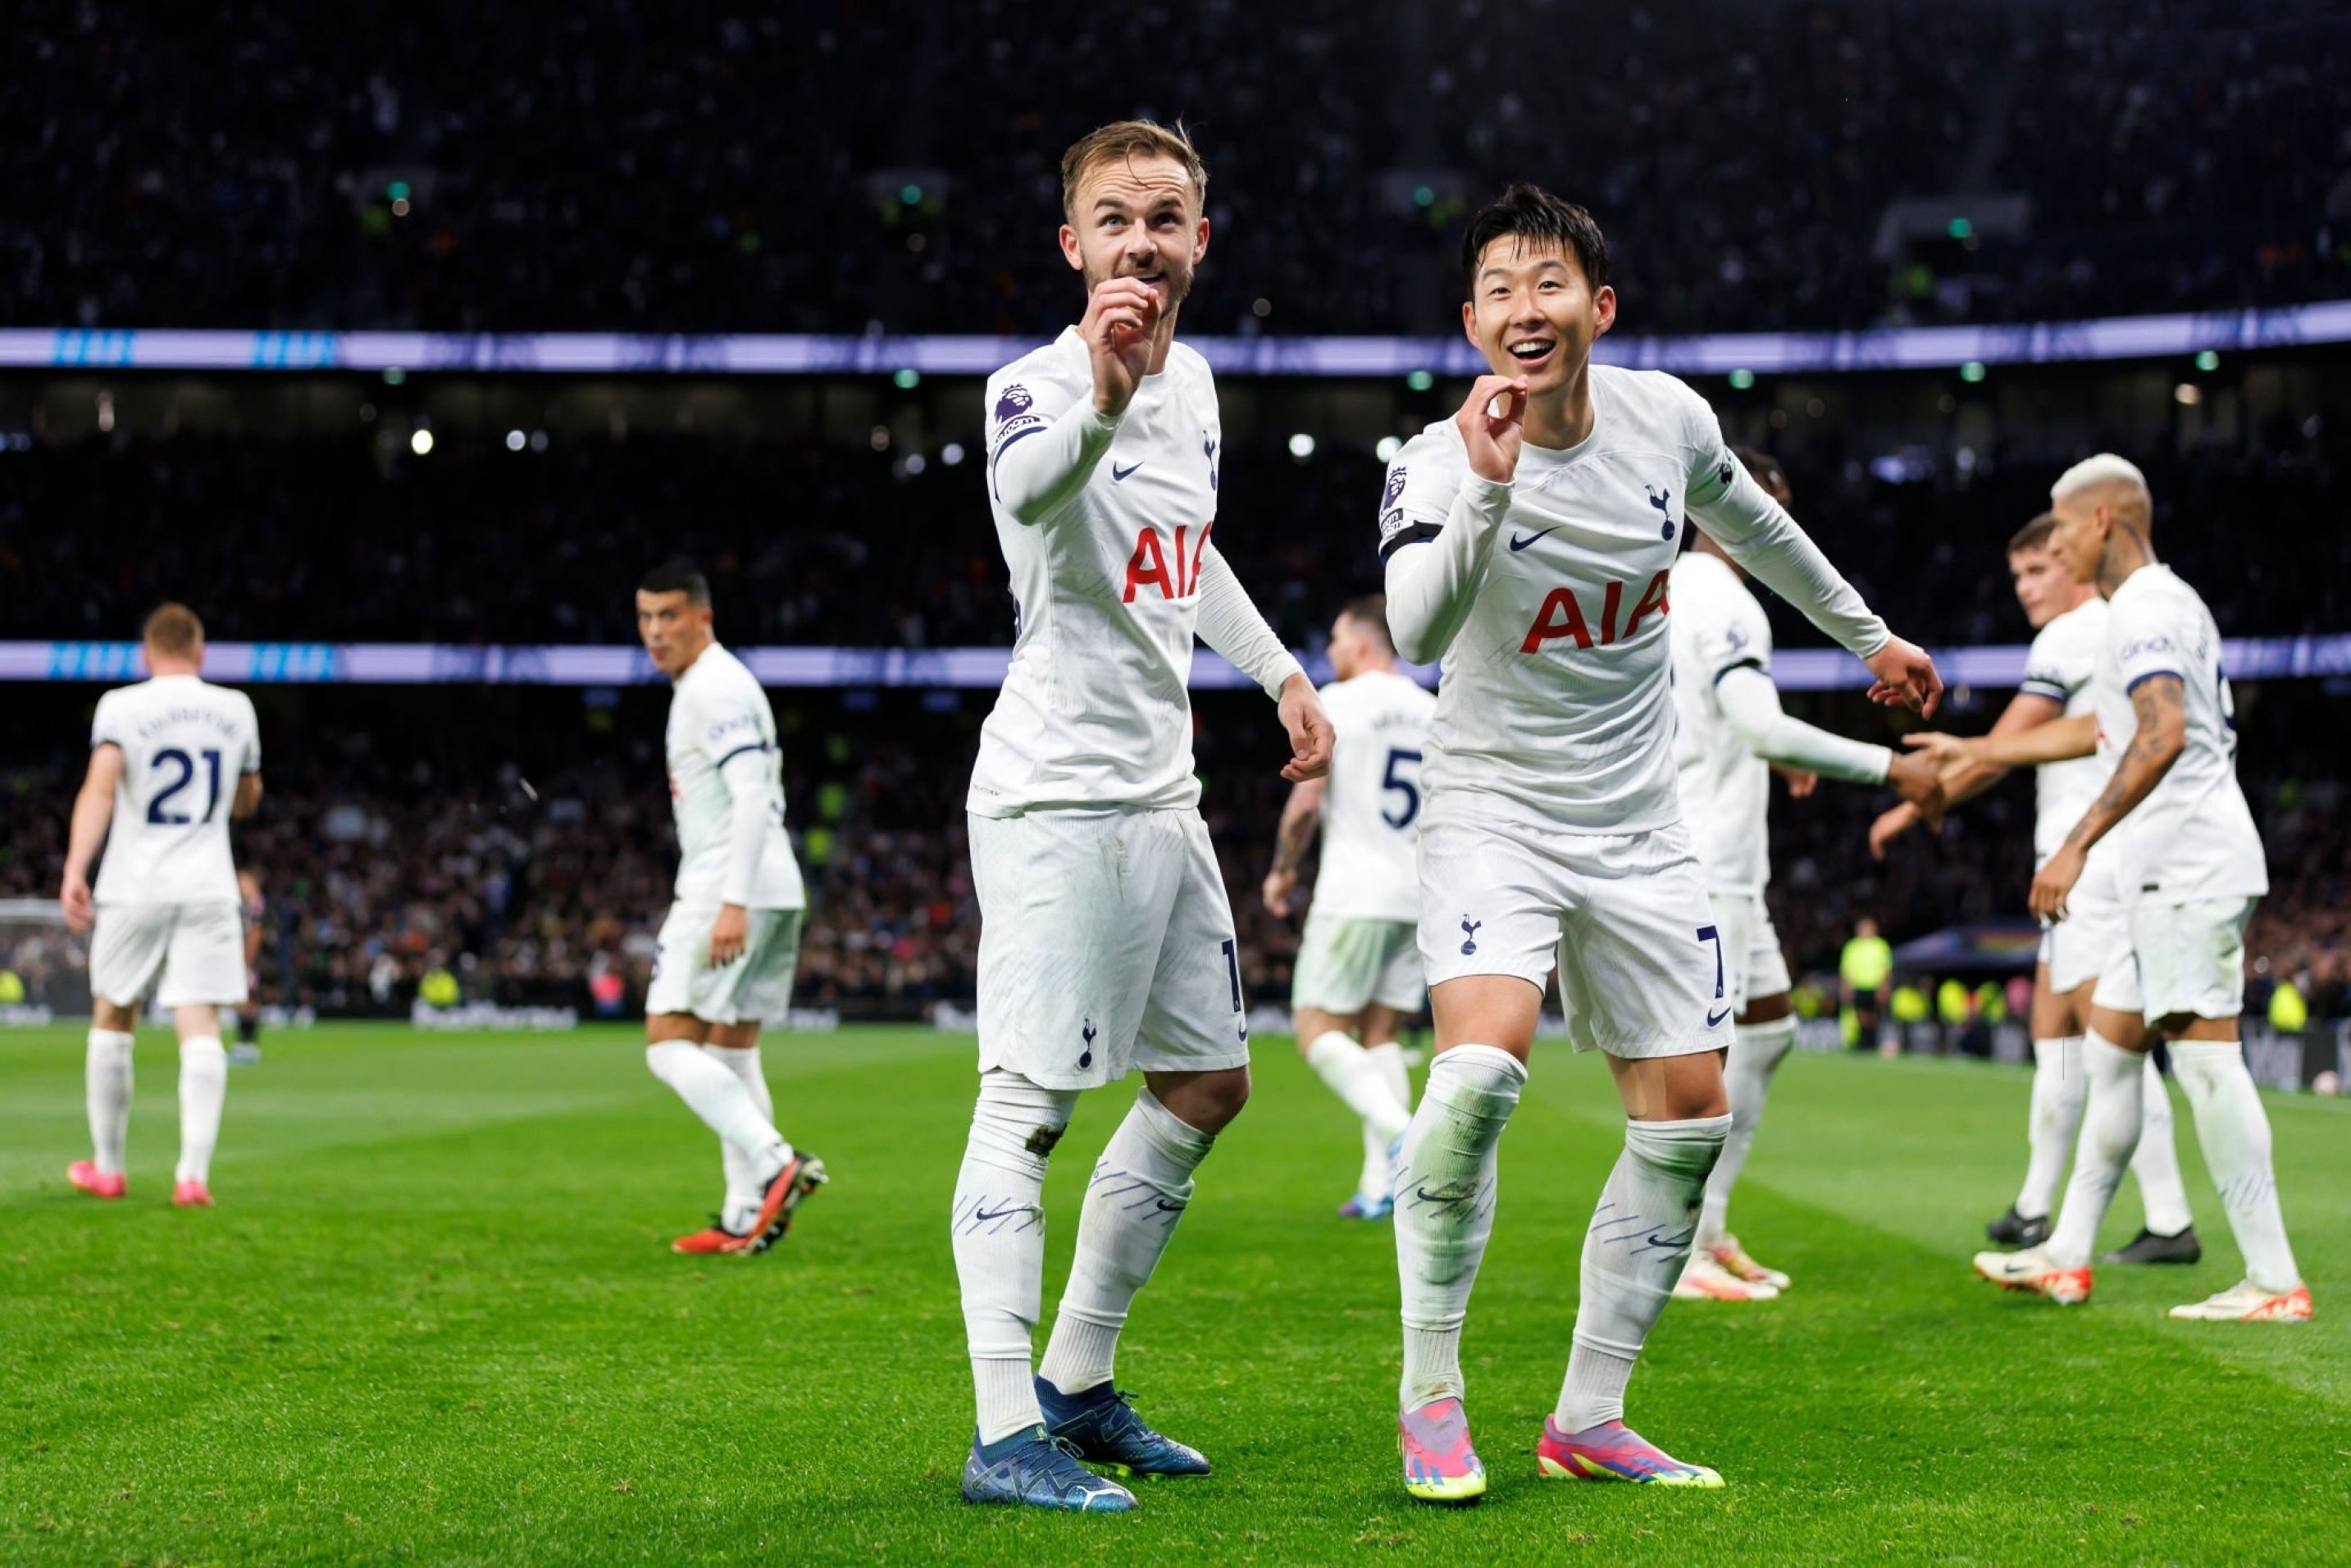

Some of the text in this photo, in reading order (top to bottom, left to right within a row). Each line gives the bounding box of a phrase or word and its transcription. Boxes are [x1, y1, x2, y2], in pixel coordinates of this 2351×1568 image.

[1519, 568, 1670, 654] AIA
[147, 747, 221, 824] 21
[1381, 748, 1424, 830] 5
[1697, 924, 1724, 999] 7
